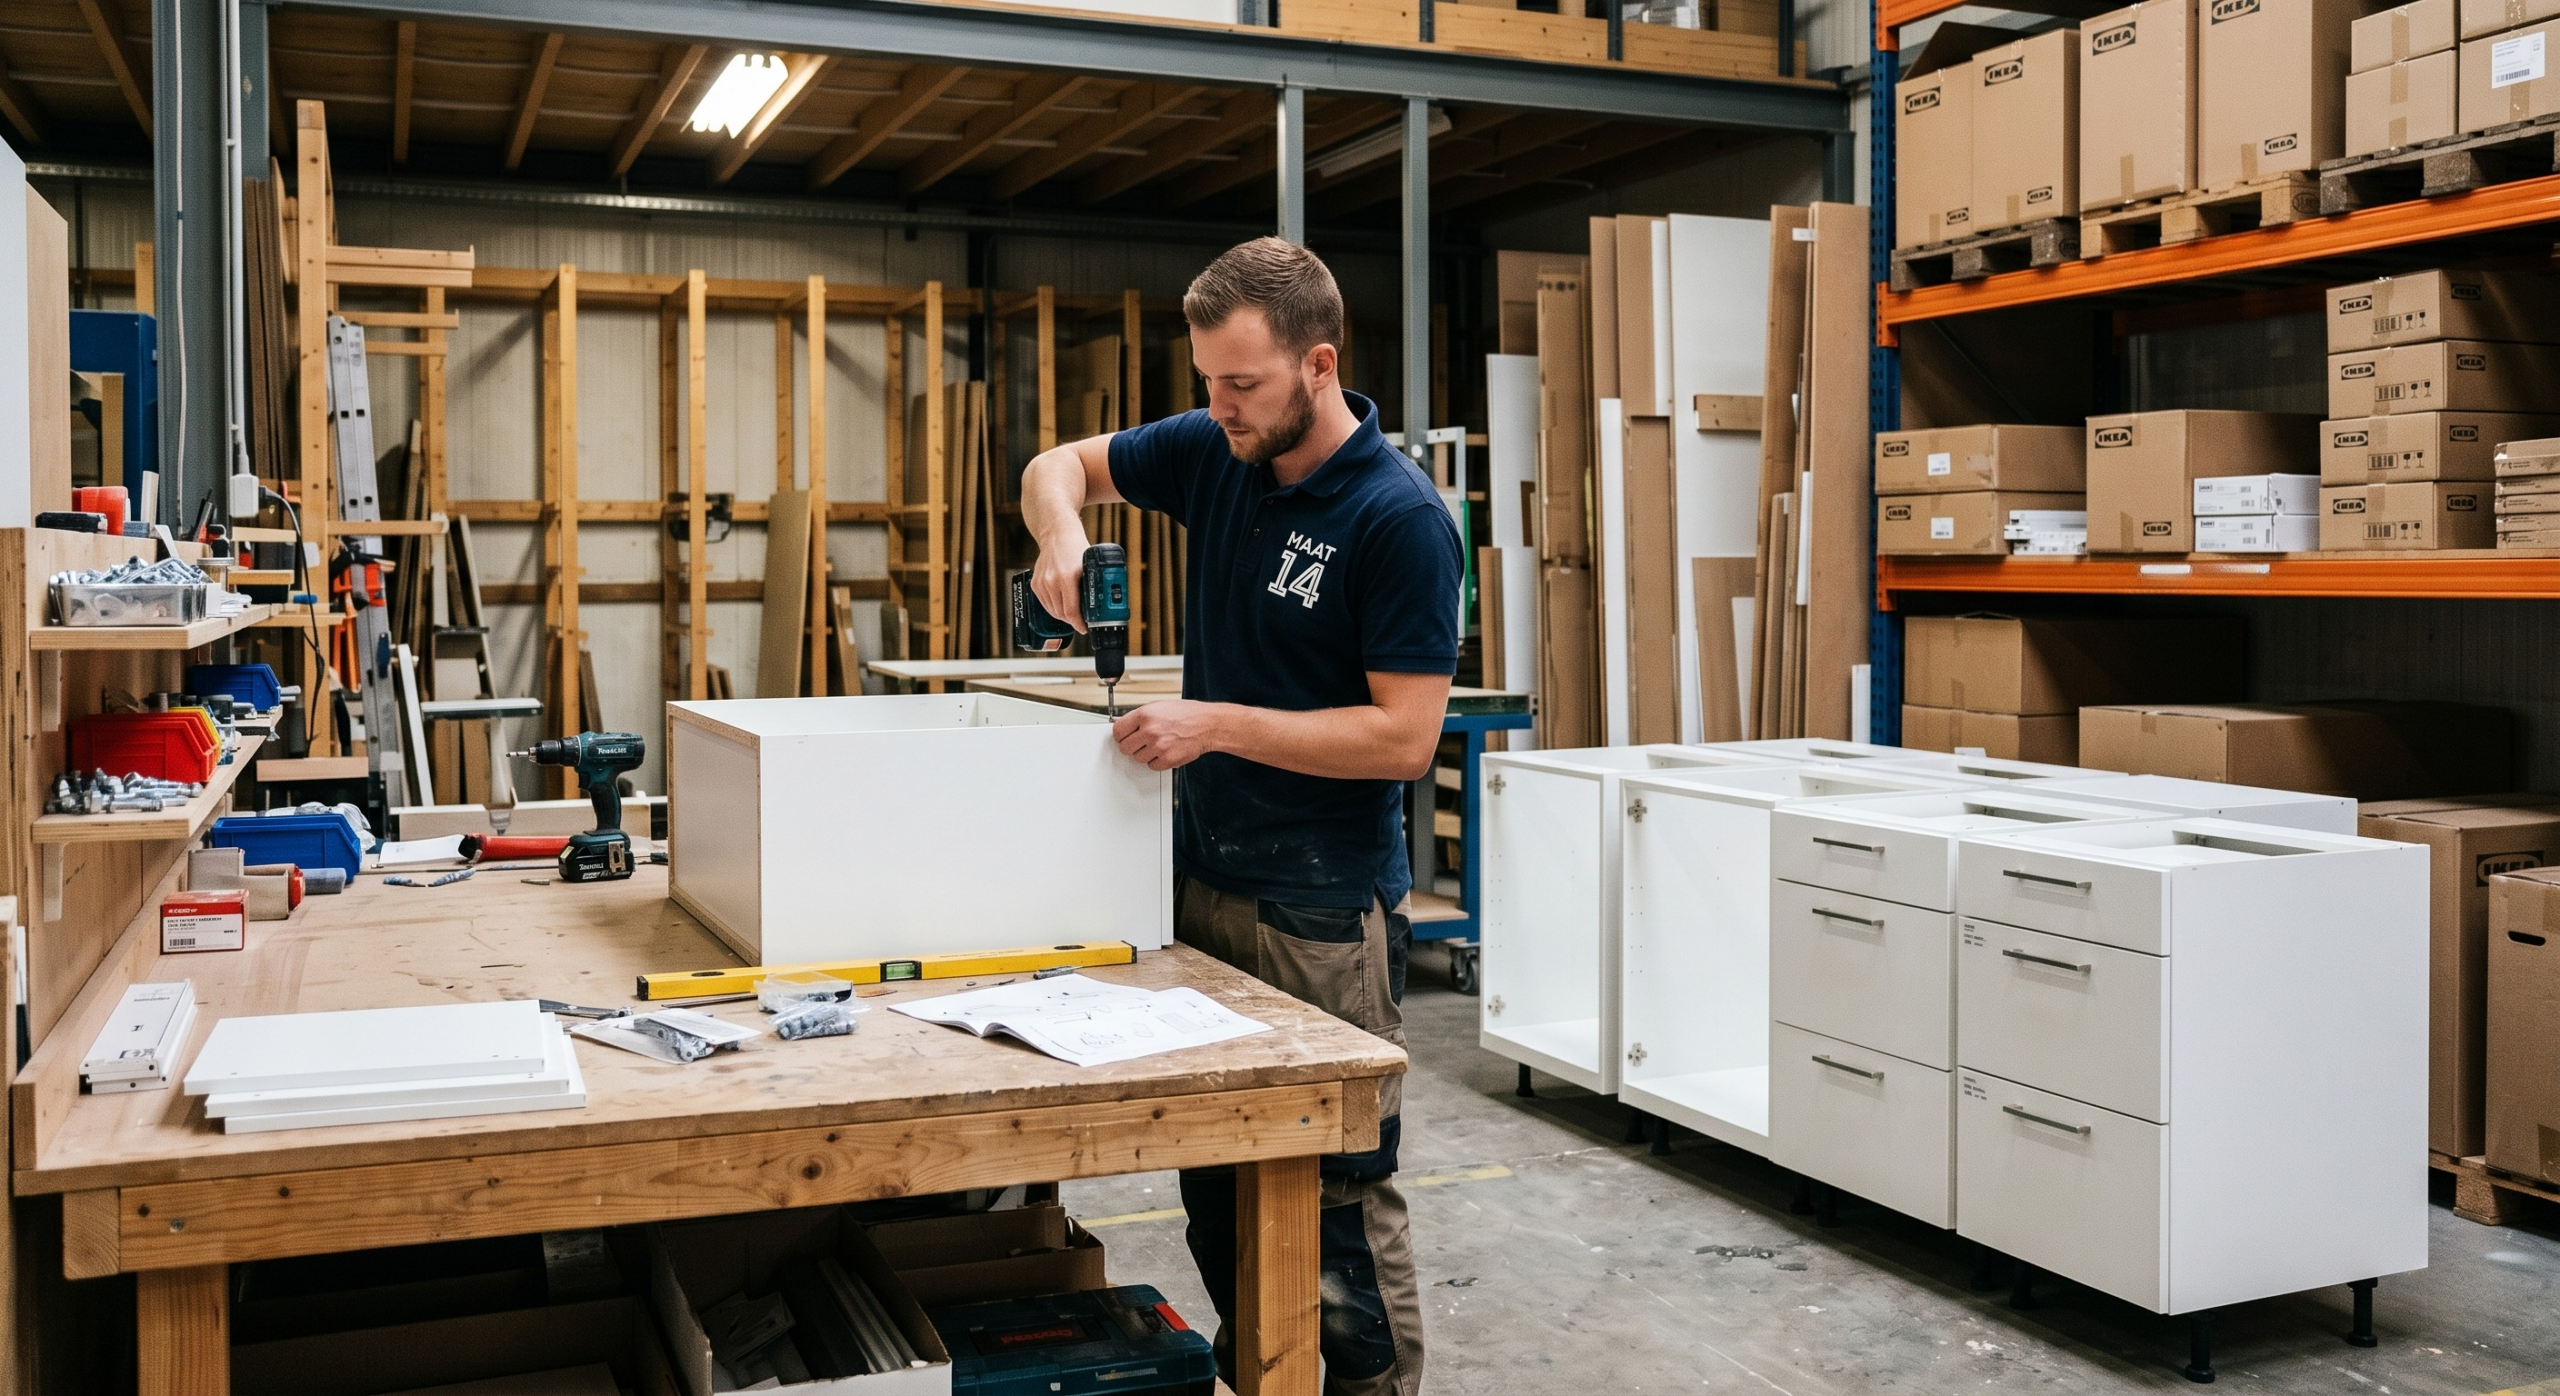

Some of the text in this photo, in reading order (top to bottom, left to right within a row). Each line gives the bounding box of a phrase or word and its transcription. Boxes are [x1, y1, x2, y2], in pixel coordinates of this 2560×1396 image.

[2216, 0, 2256, 16] IKEA
[2097, 29, 2132, 48] IKEA
[2098, 432, 2129, 443] IKEA
[1286, 530, 1338, 562] MAAT
[1267, 549, 1325, 609] 14
